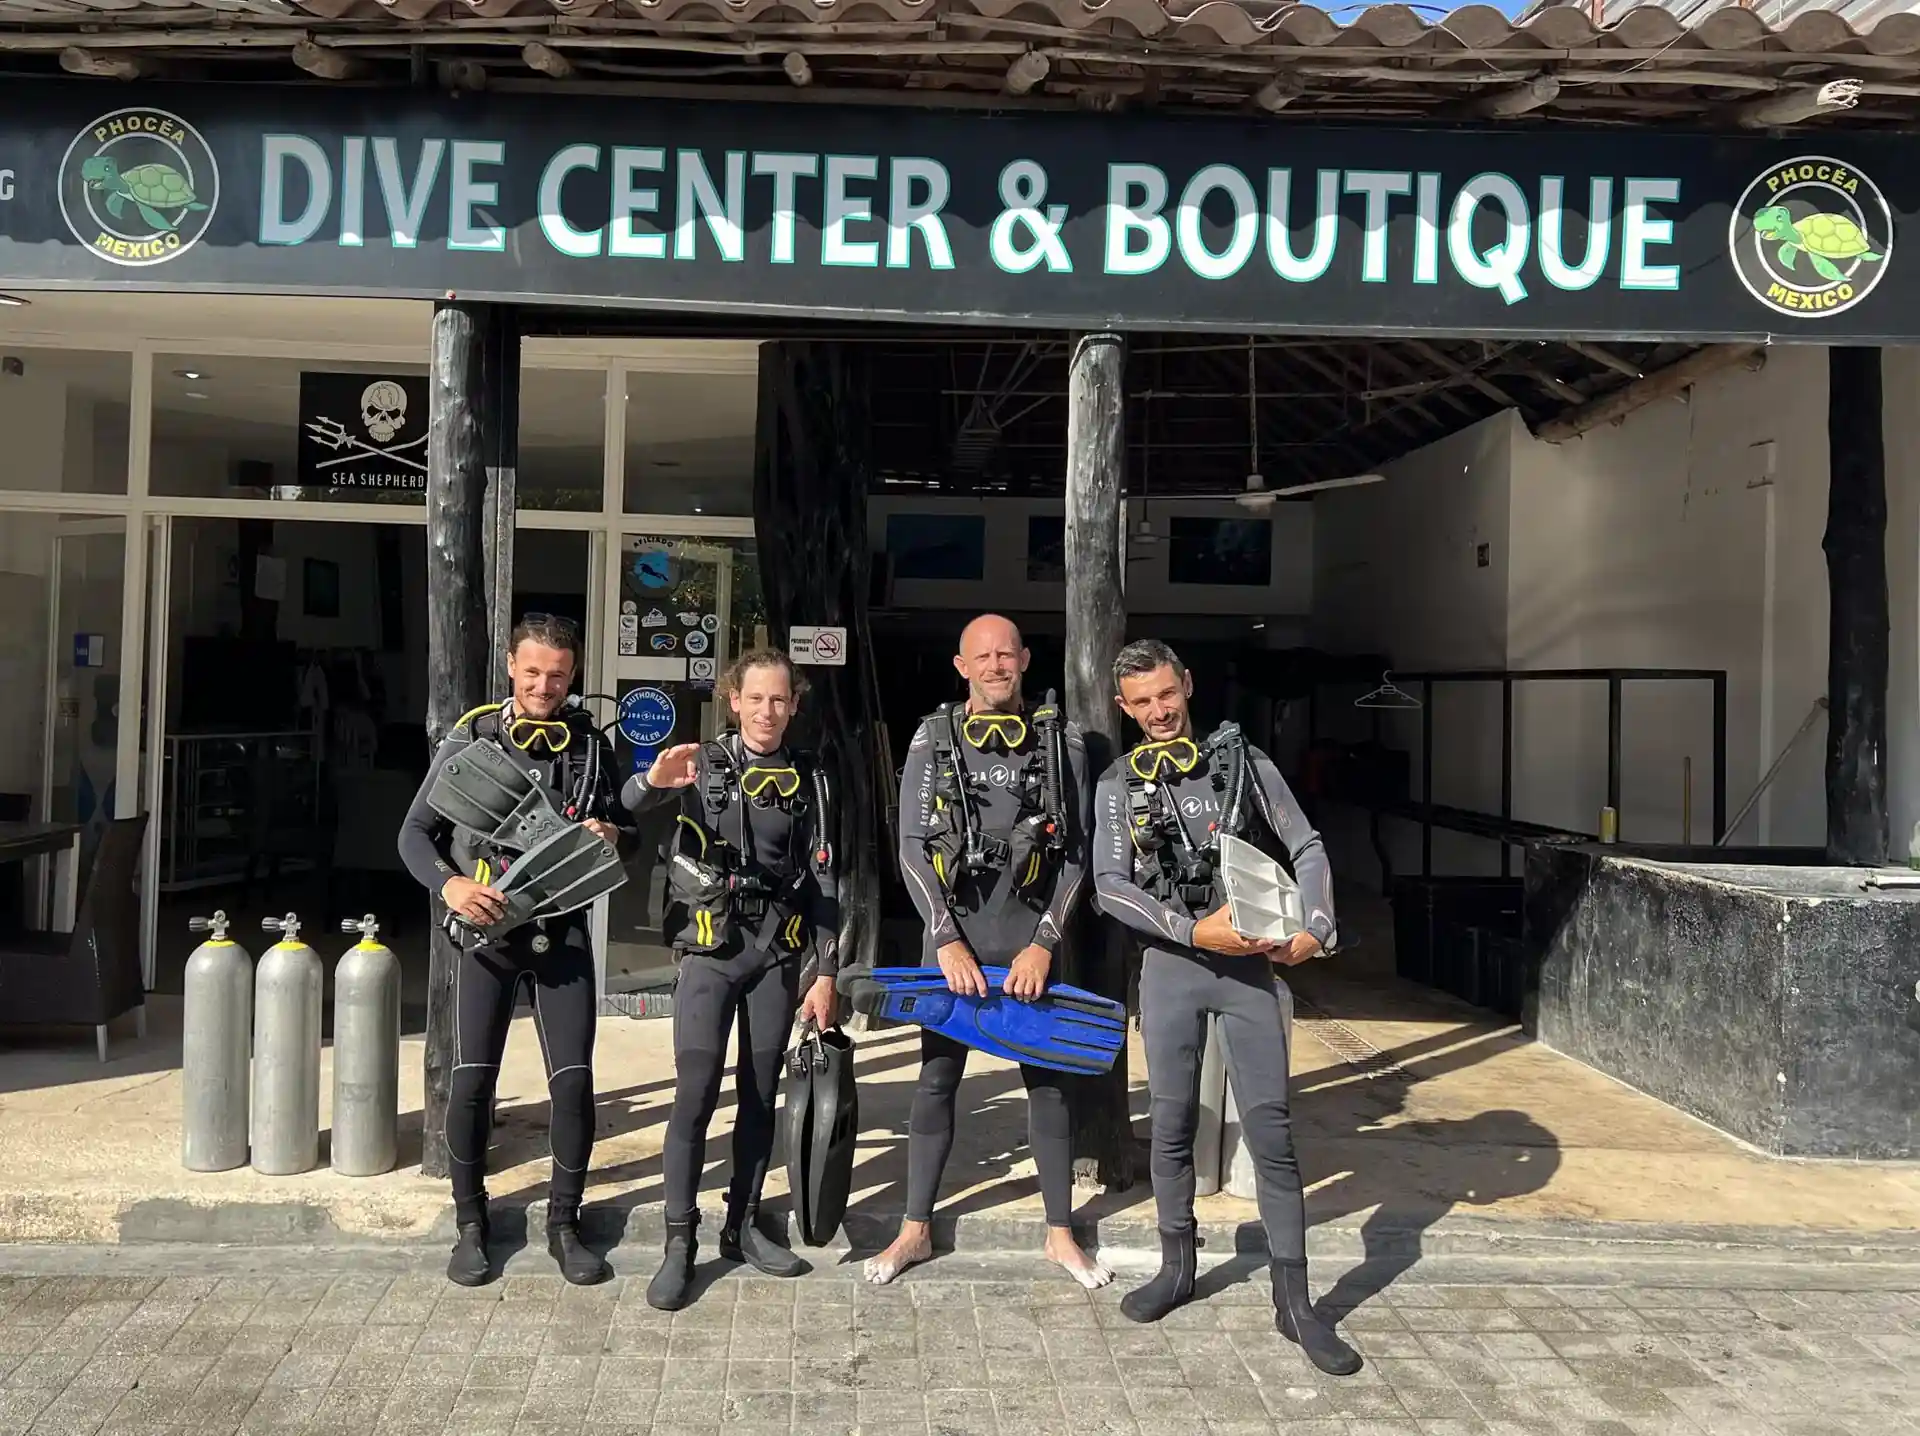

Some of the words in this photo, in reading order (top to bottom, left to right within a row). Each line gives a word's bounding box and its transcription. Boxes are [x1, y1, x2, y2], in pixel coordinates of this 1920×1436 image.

[94, 116, 186, 147] PHOCÉA
[1766, 164, 1860, 195] PHOCÉA
[258, 133, 505, 252] DIVE
[537, 142, 956, 270] CENTER
[990, 159, 1074, 274] &
[1103, 162, 1681, 305] BOUTIQUE
[94, 232, 181, 259] MEXICO
[1766, 282, 1854, 310] MEXICO
[332, 472, 356, 485] SEA
[361, 473, 425, 488] SHEPHERD
[633, 536, 674, 549] AFILIADO
[625, 691, 670, 711] AUTHORIZED
[629, 729, 661, 742] DEALER
